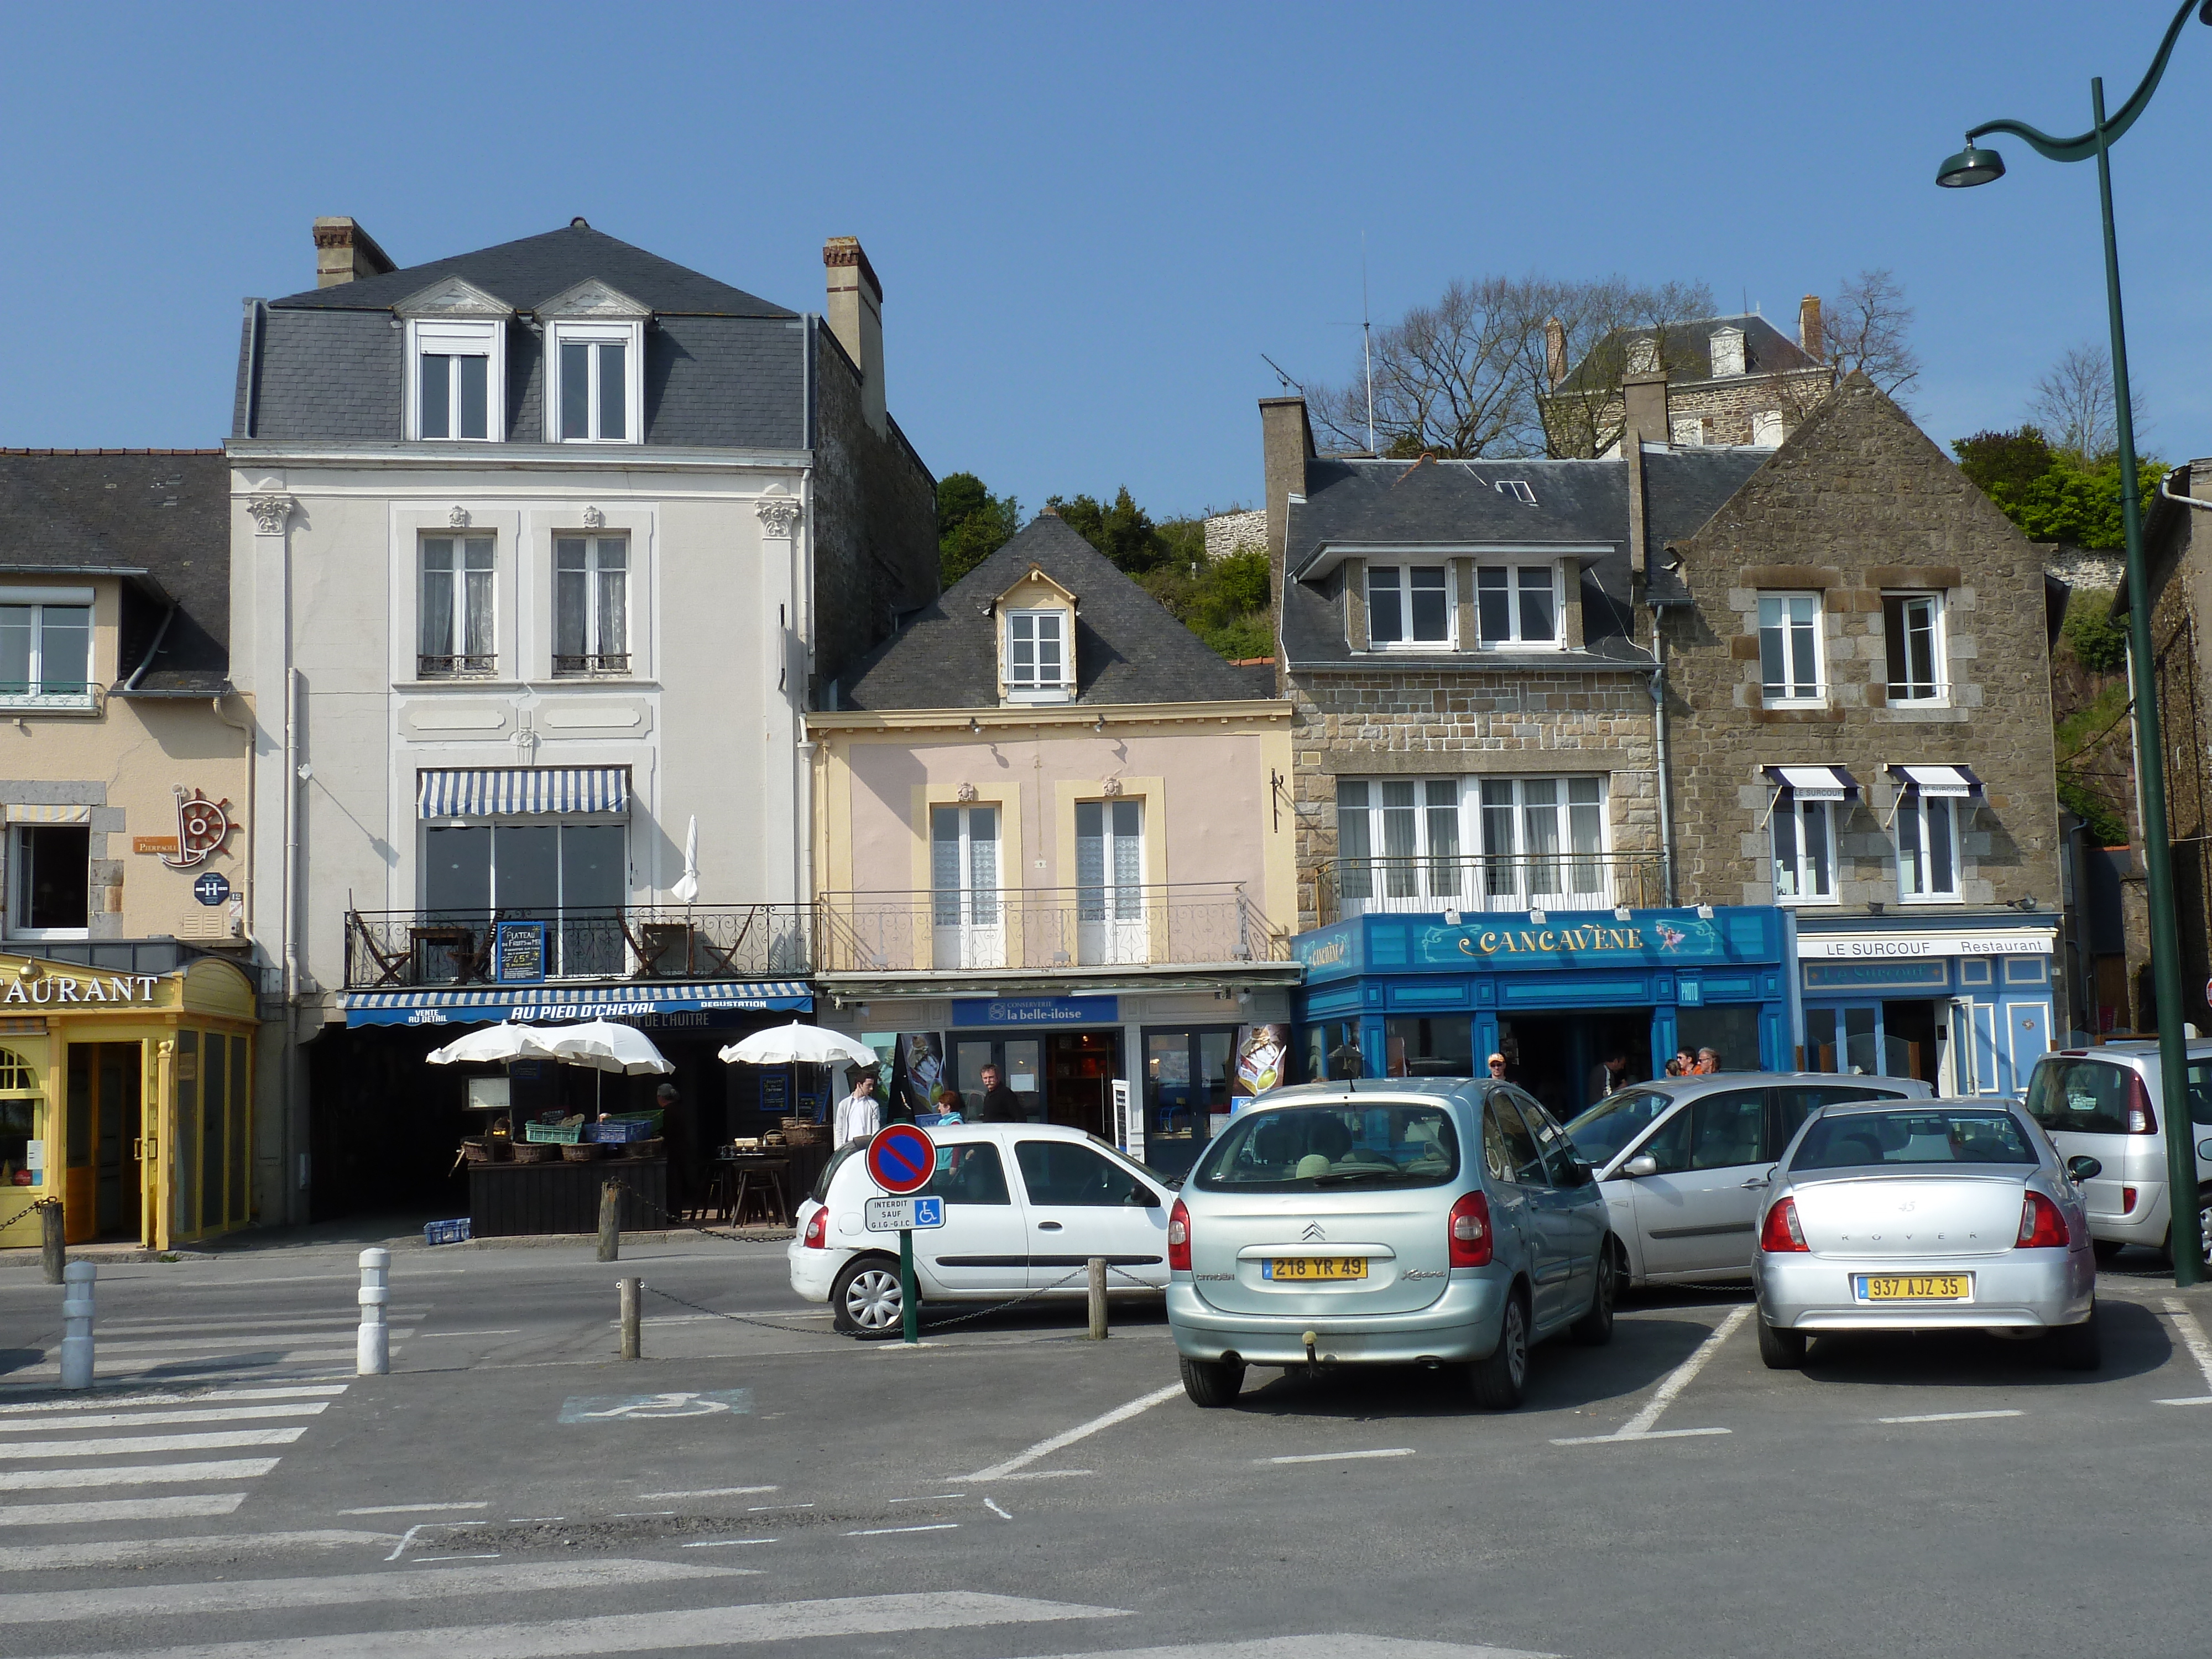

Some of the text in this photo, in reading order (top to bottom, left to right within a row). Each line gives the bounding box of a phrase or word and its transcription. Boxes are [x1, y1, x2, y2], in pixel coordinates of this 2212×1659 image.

[205, 883, 218, 896] H
[1459, 924, 1644, 956] CANCAVÈNE
[1827, 941, 2043, 955] LE SURCOUF Restaurant
[0, 977, 158, 1003] AURANT
[1681, 982, 1698, 1000] PHOTO
[511, 1002, 657, 1020] AU PIED D'CHEVAL
[1007, 1008, 1082, 1020] la belle-iloise
[421, 1015, 448, 1023] DETAIL
[645, 1014, 659, 1027] DE
[662, 1013, 709, 1026] L'HUITRE
[874, 1200, 907, 1208] INTERDIT
[1898, 1201, 1916, 1212] 45
[1841, 1232, 1977, 1241] ROVER
[1276, 1260, 1306, 1276] 218
[1314, 1259, 1334, 1275] YR
[1342, 1258, 1361, 1275] 49
[1874, 1280, 1900, 1296] 937
[1908, 1279, 1933, 1295] AJZ
[1940, 1278, 1958, 1295] 35
